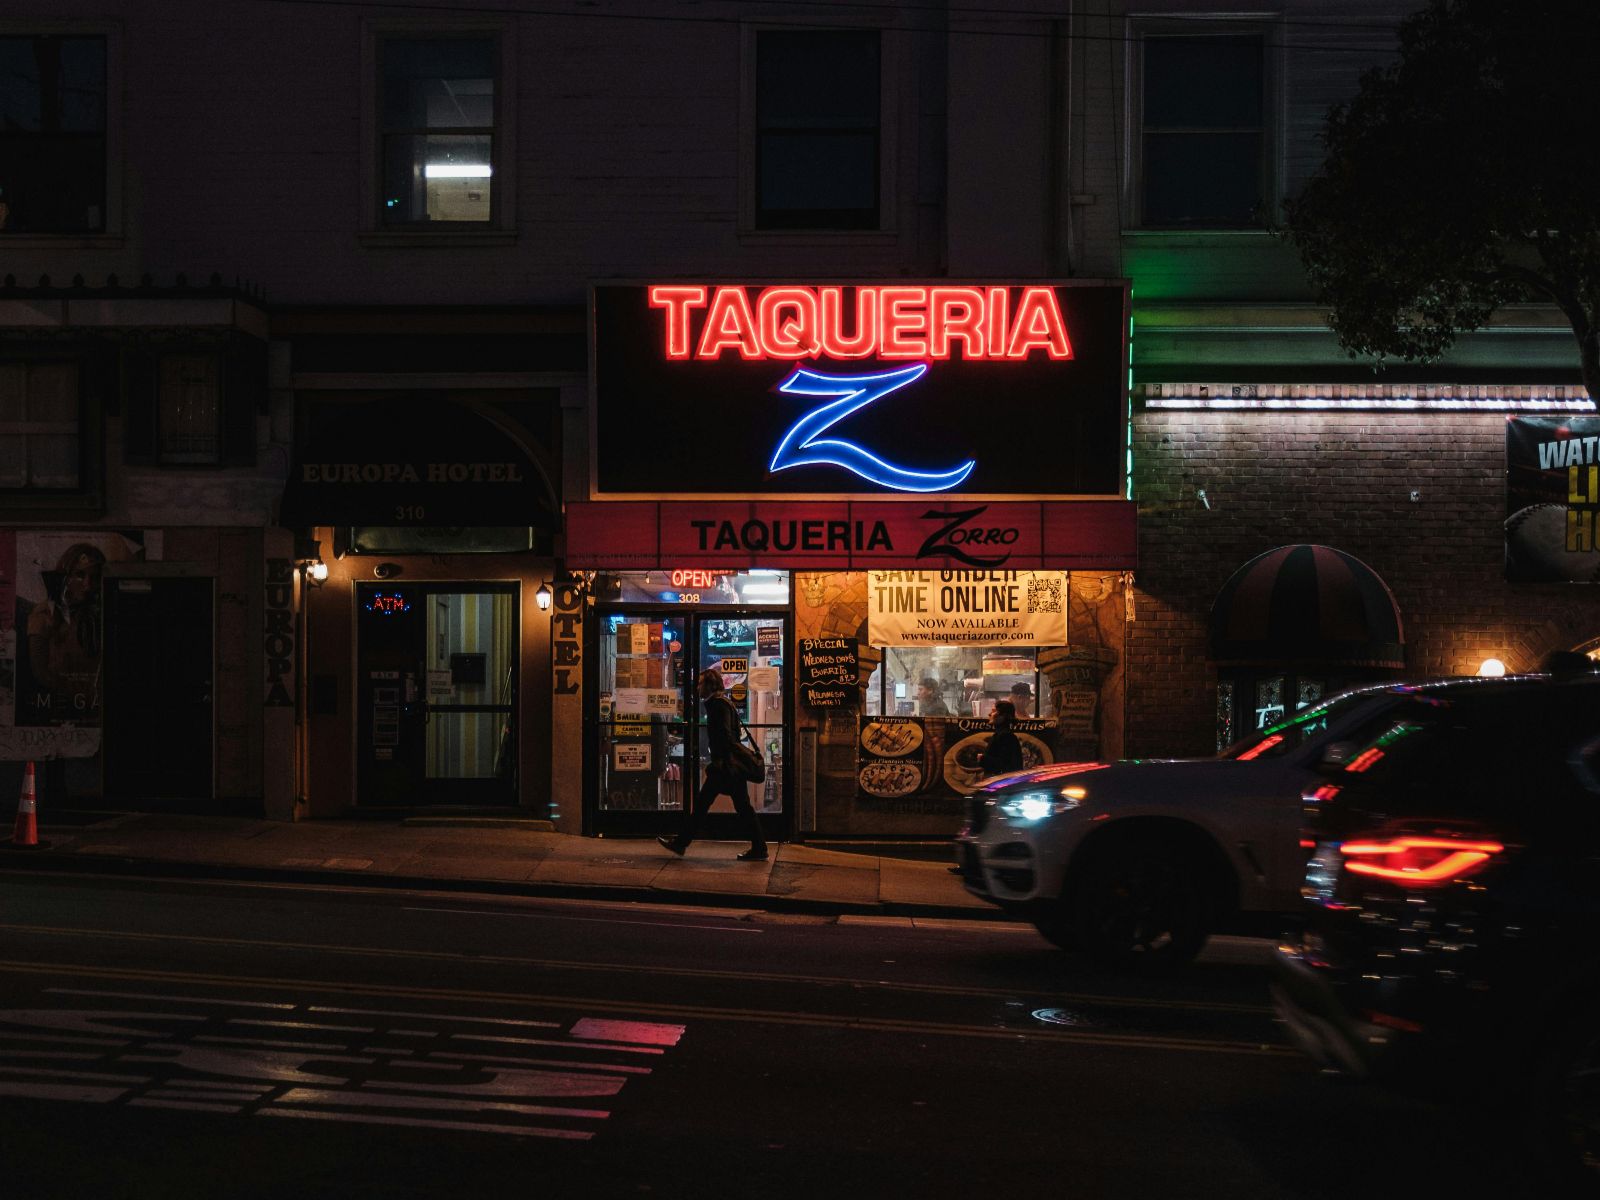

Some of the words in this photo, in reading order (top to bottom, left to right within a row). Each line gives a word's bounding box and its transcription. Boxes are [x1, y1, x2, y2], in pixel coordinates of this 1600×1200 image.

[648, 284, 1075, 361] TAQUERIA
[767, 363, 977, 493] Z
[1537, 436, 1600, 471] WAT
[302, 463, 420, 483] EUROPA
[427, 463, 523, 483] HOTEL
[395, 506, 425, 520] 310
[691, 519, 894, 553] TAQUERIA
[671, 570, 712, 588] OPEN
[372, 597, 405, 612] ATM
[678, 593, 700, 604] 308
[875, 586, 928, 614] TIME
[939, 585, 1020, 614] ONLINE
[265, 558, 294, 707] EUROPA
[917, 618, 949, 629] NOW
[951, 618, 1020, 629] AVAILABLE
[553, 584, 583, 695] OTEL
[803, 639, 848, 651] SPECIAL
[901, 631, 1035, 643] www.taqueriazorro.com
[722, 660, 747, 671] OPEN
[616, 713, 641, 721] SMILE
